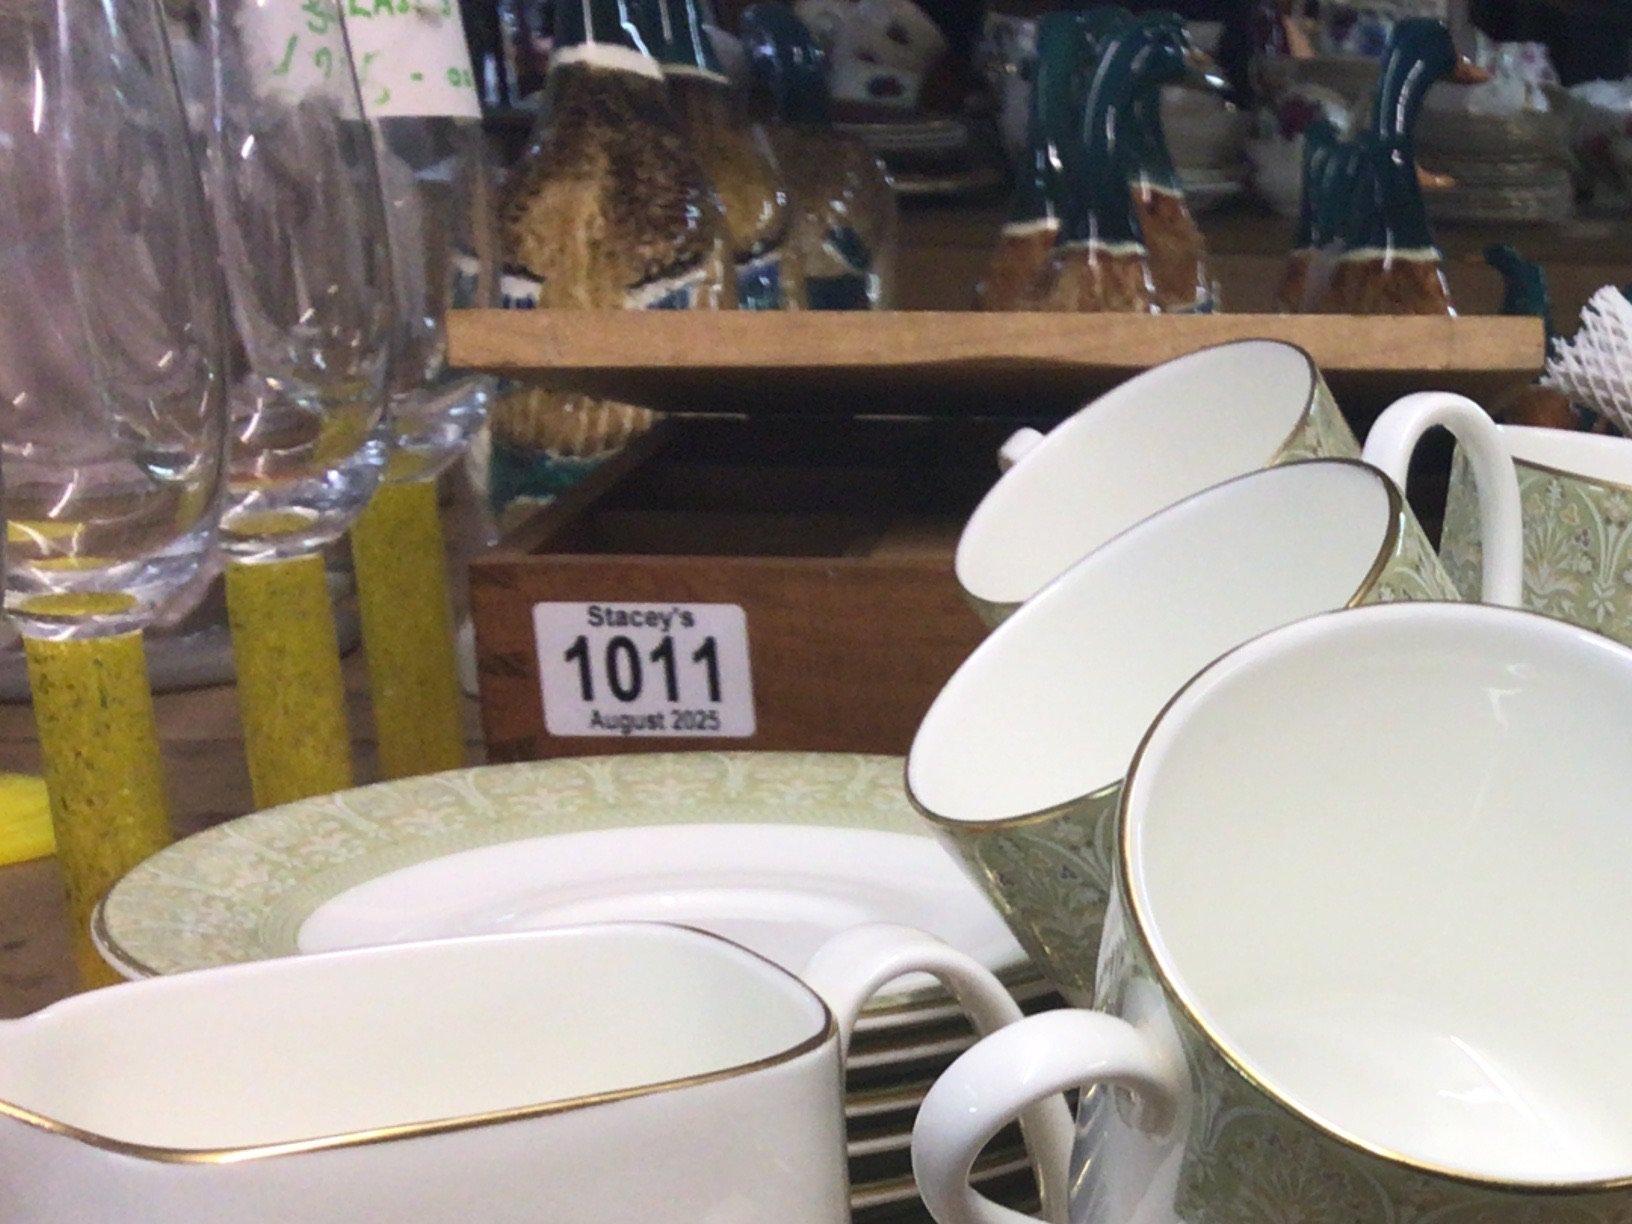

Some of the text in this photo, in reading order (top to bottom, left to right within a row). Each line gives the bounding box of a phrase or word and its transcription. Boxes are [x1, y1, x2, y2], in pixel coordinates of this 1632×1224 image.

[587, 605, 695, 631] Stacey's
[564, 635, 722, 702] 1011
[590, 709, 721, 737] August 2025
